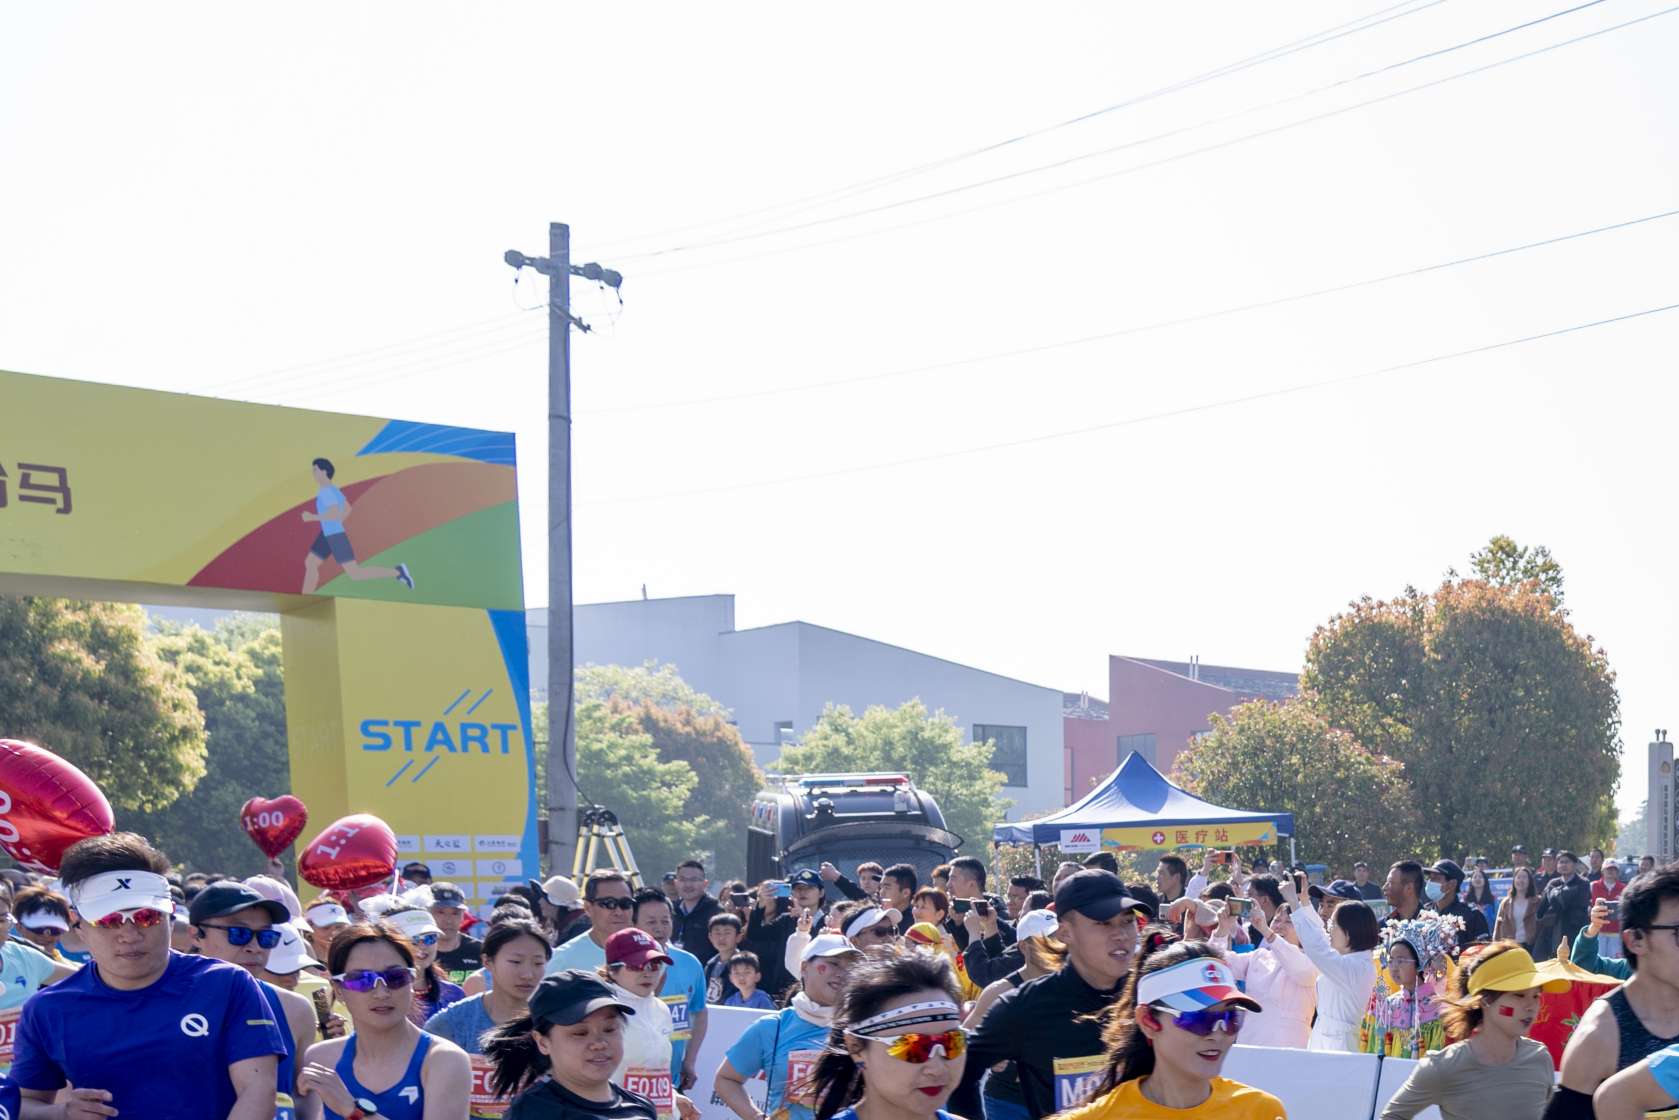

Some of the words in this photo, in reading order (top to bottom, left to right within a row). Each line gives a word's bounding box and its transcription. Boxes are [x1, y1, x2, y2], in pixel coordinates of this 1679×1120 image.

[0, 462, 72, 515] 马
[360, 719, 518, 754] START
[245, 811, 284, 831] 1:00
[1175, 829, 1229, 844] 医疗站
